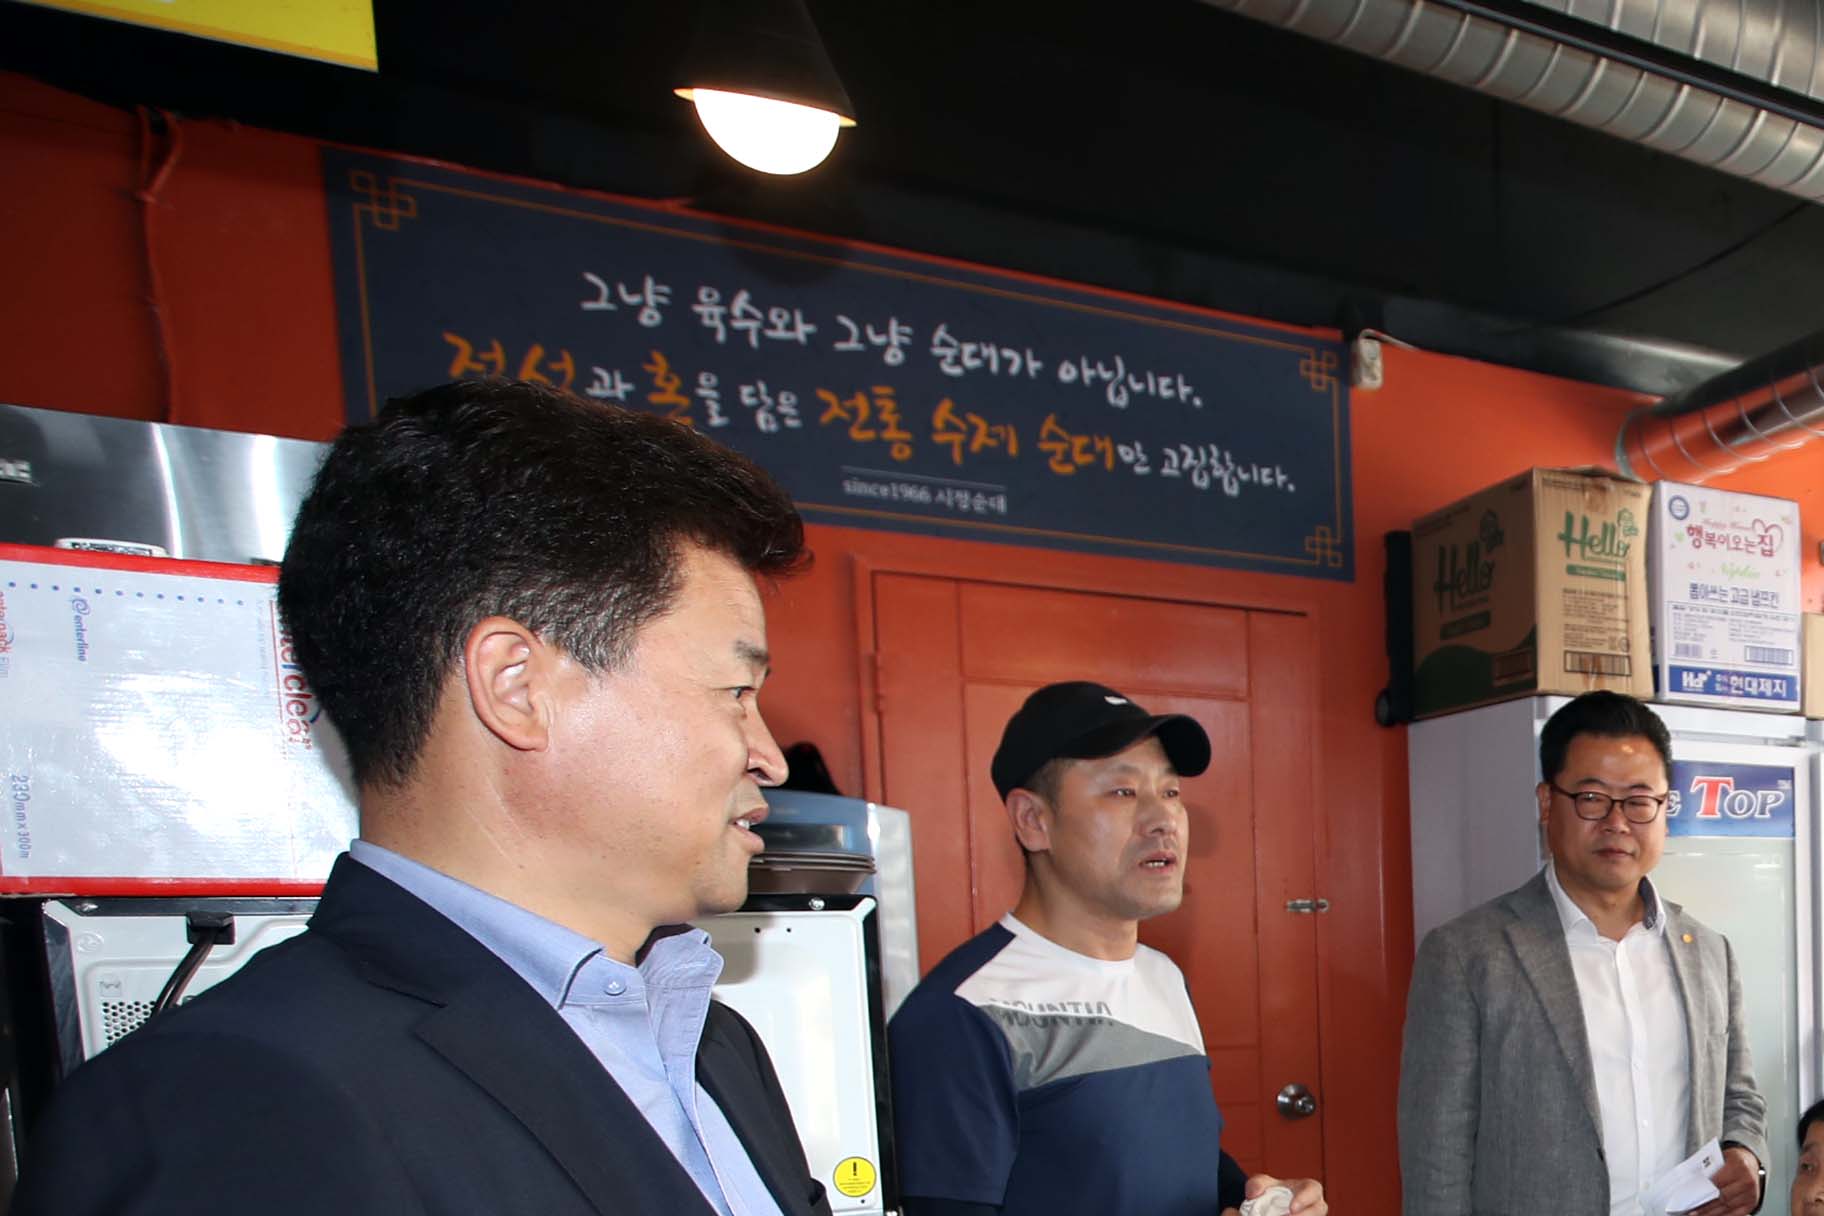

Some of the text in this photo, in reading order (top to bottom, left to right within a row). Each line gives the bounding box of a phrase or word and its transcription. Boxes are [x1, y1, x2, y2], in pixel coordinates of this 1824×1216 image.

[580, 271, 1204, 409] 그냥 육수와 그냥 순대가 아닙니다.
[739, 380, 803, 433] 담은
[815, 385, 913, 462] 전통
[932, 397, 1019, 466] 수제
[1161, 443, 1297, 498] 고집합니다.
[1557, 510, 1631, 561] Hello
[1433, 540, 1496, 614] Hello
[1729, 675, 1787, 697] 현대제지
